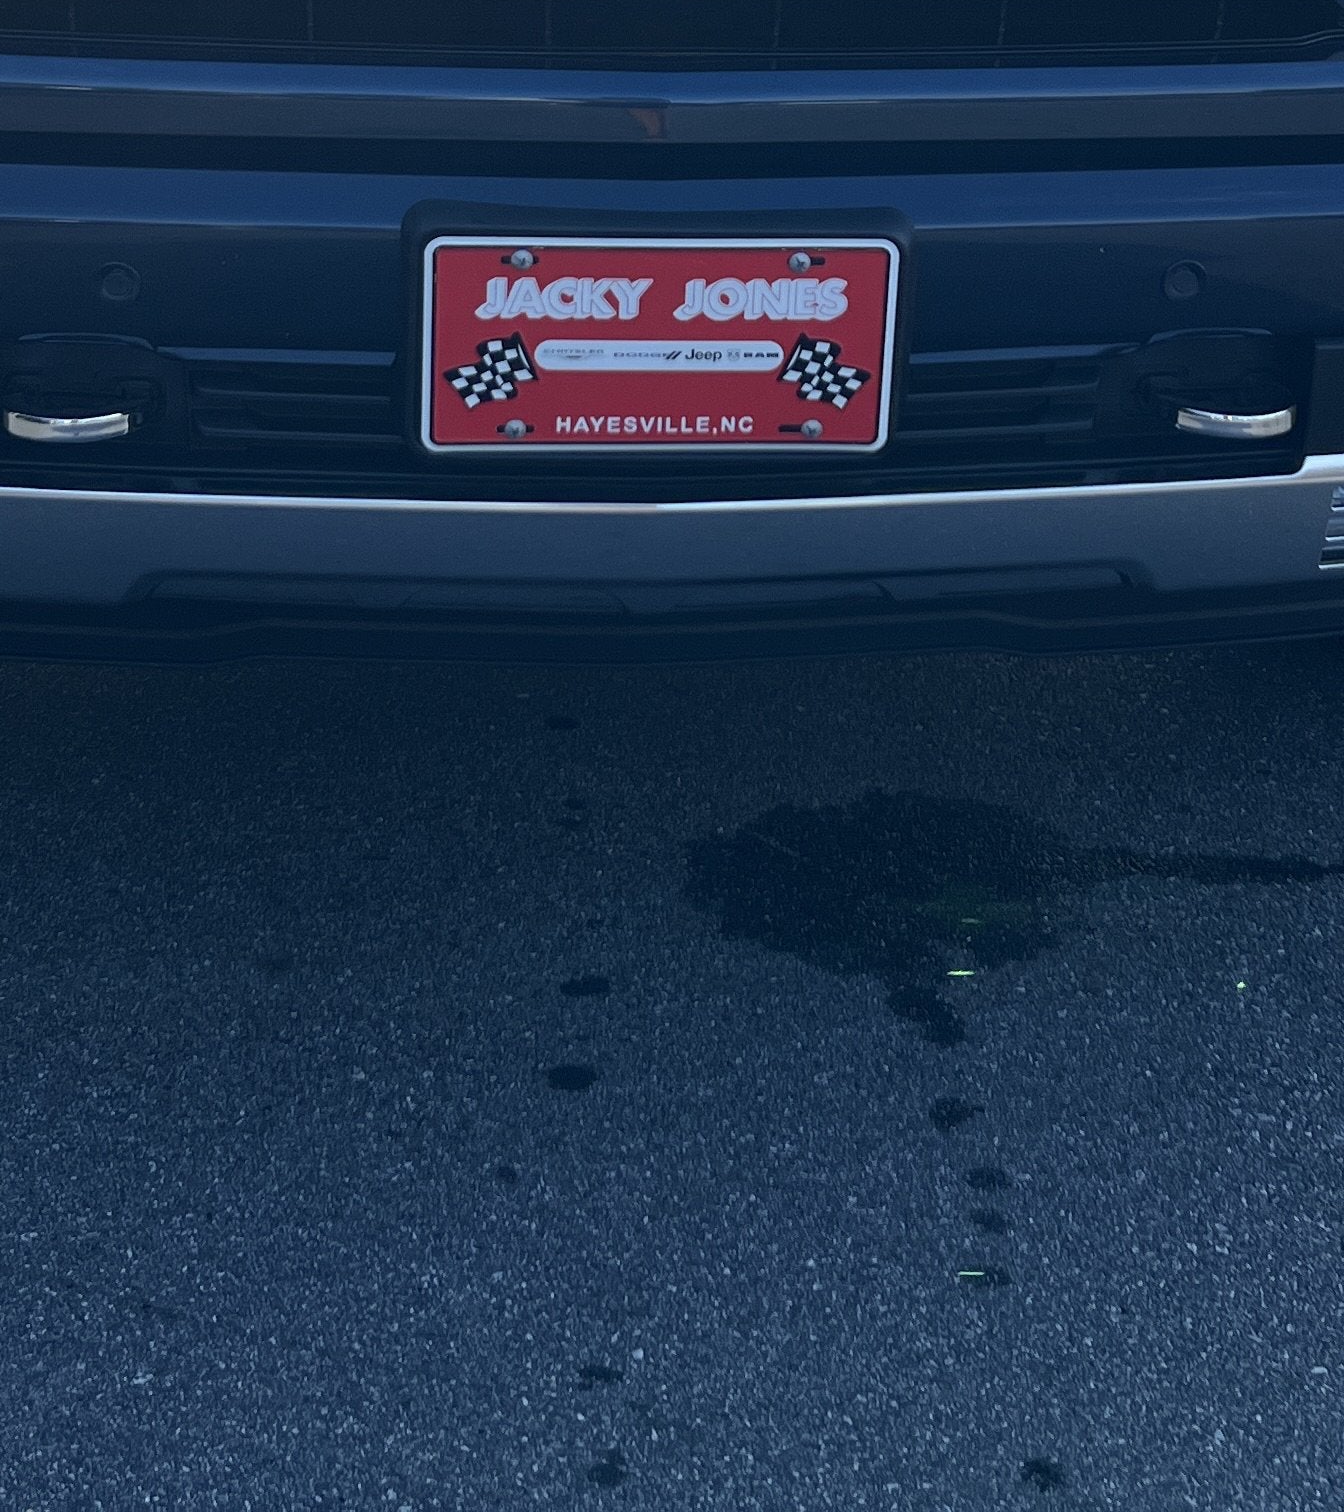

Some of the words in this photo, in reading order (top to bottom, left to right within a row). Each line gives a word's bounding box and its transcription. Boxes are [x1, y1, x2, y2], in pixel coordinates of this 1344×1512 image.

[474, 276, 654, 321] JACKY
[673, 277, 848, 322] JONES
[685, 348, 723, 362] Jeep
[555, 415, 754, 436] HAYESVILLE,NC
